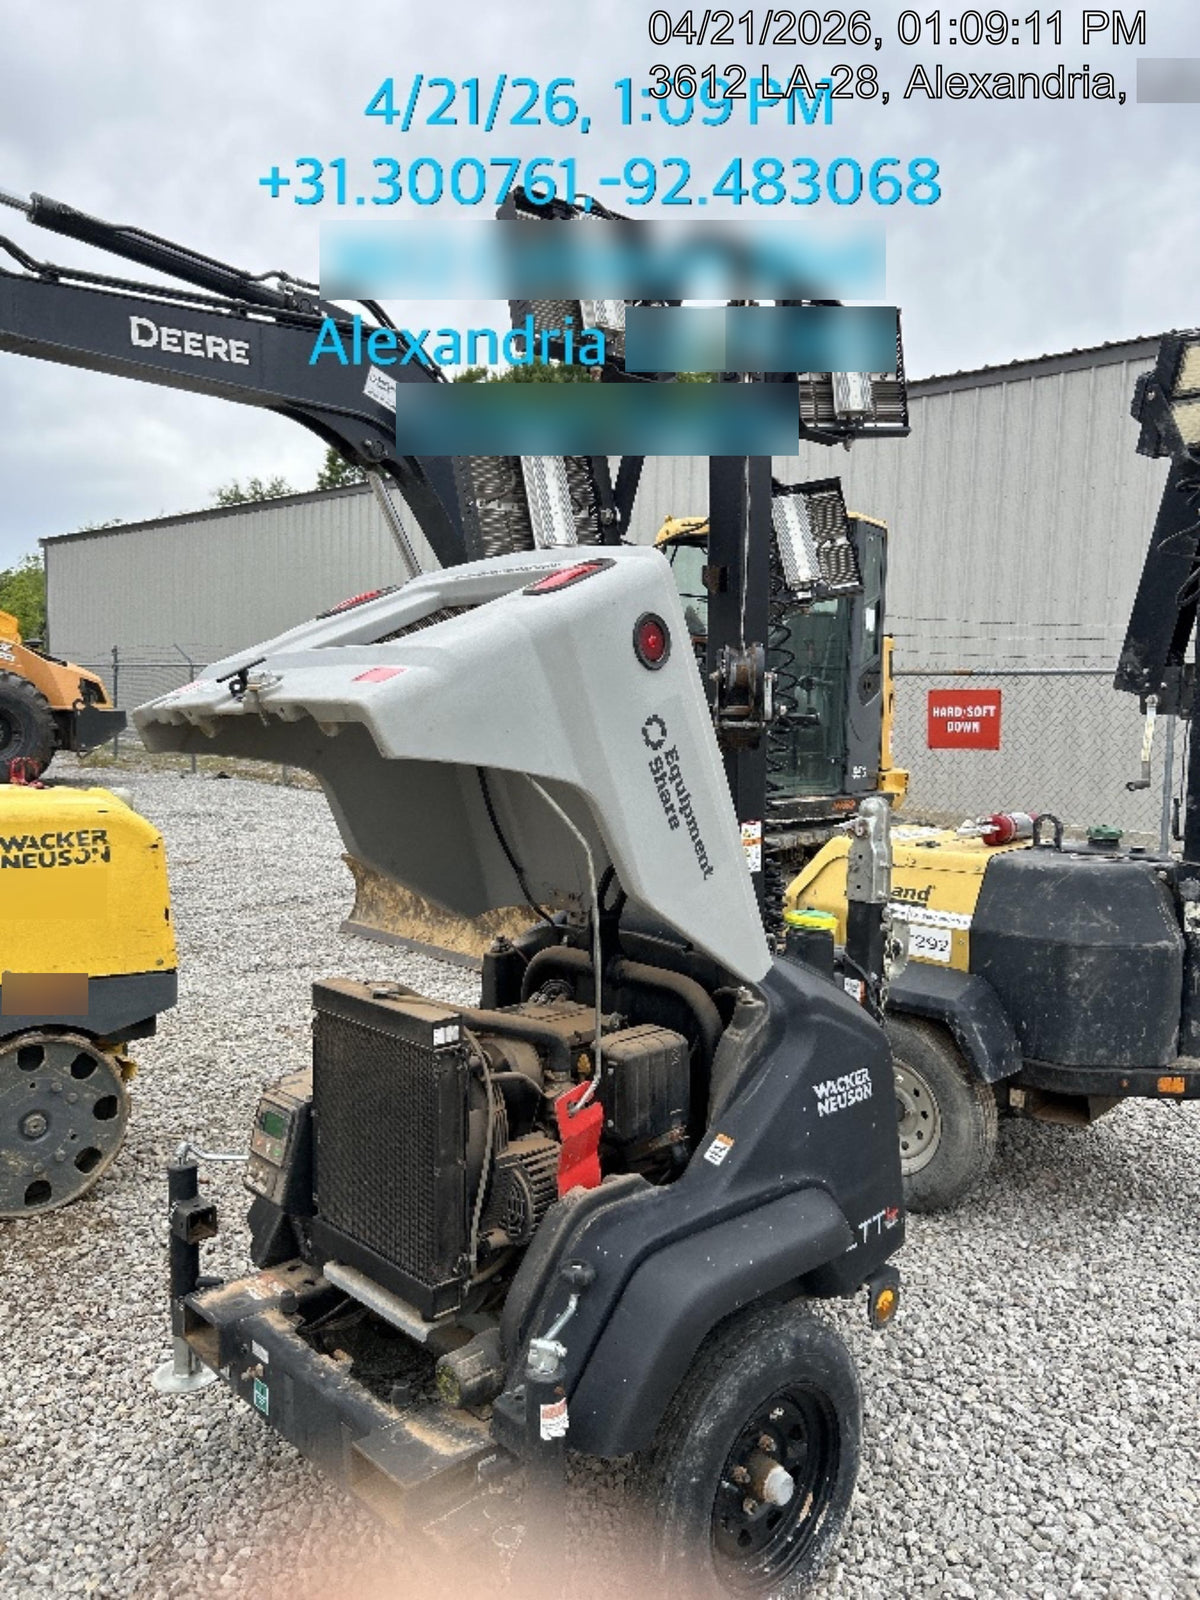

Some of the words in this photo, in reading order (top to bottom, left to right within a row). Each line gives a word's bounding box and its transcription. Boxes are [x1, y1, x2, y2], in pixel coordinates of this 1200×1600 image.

[129, 315, 249, 365] DEERE
[947, 721, 980, 733] DOWN
[649, 755, 681, 831] Share
[664, 744, 714, 880] Equipment
[0, 829, 109, 854] WACKER
[1, 846, 111, 868] NEUSON
[812, 1068, 872, 1100] WACKER
[817, 1082, 873, 1118] NEUSON
